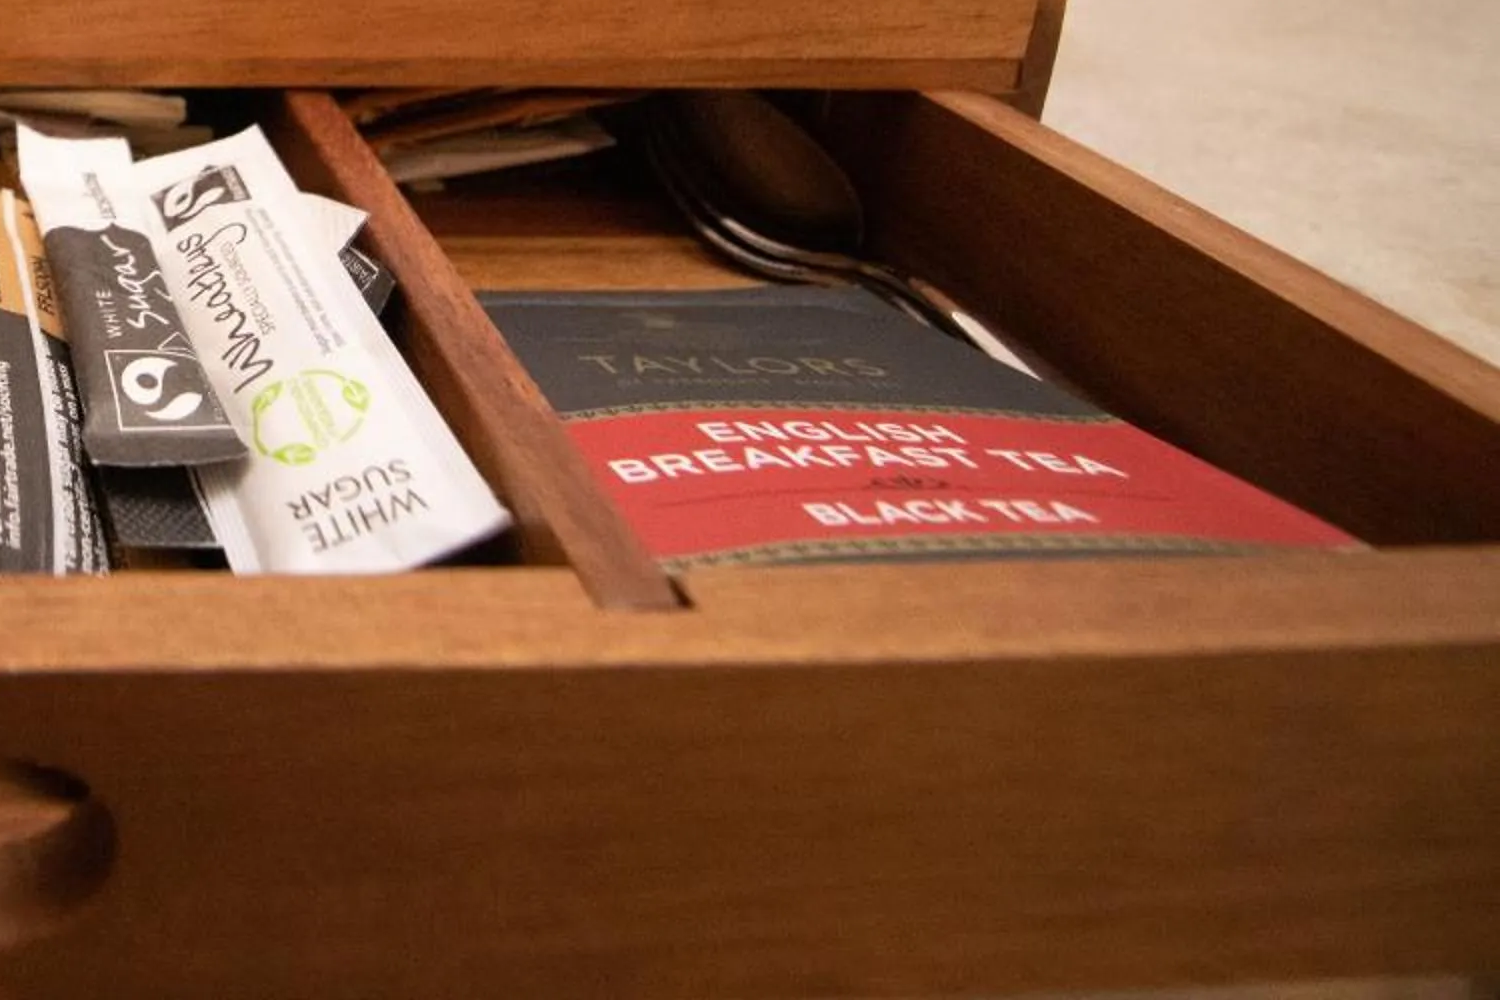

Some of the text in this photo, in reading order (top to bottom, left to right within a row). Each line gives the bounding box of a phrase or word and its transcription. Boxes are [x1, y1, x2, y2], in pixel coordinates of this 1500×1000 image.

[96, 289, 122, 338] WHITE
[177, 222, 274, 394] Wheatleys
[578, 355, 887, 378] TAYLORS
[697, 420, 968, 445] ENGLISH
[608, 444, 1129, 484] BREAKFAST TEA
[288, 459, 412, 521] SUGAR
[302, 488, 429, 553] WHITE
[802, 500, 1100, 526] BLACK TEA
